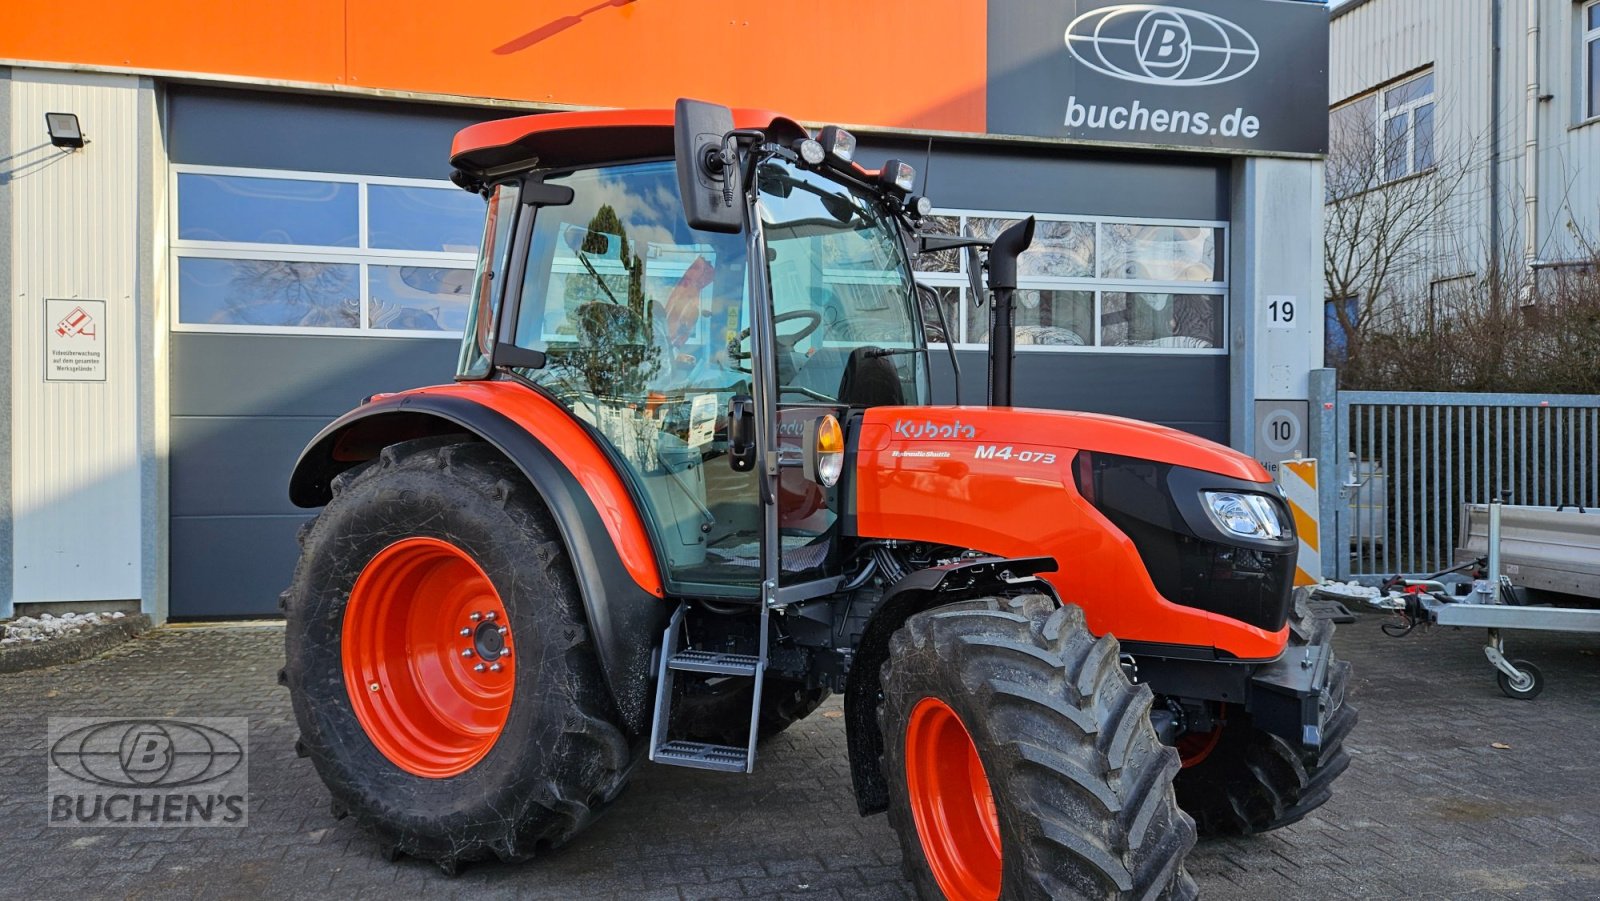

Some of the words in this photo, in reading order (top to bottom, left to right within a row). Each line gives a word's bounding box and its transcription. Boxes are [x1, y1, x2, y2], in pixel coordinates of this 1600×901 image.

[1064, 95, 1260, 138] buchens.de
[1269, 301, 1294, 322] 19
[895, 419, 976, 438] Kubota
[1272, 421, 1291, 441] 10
[974, 445, 1057, 464] M4-073
